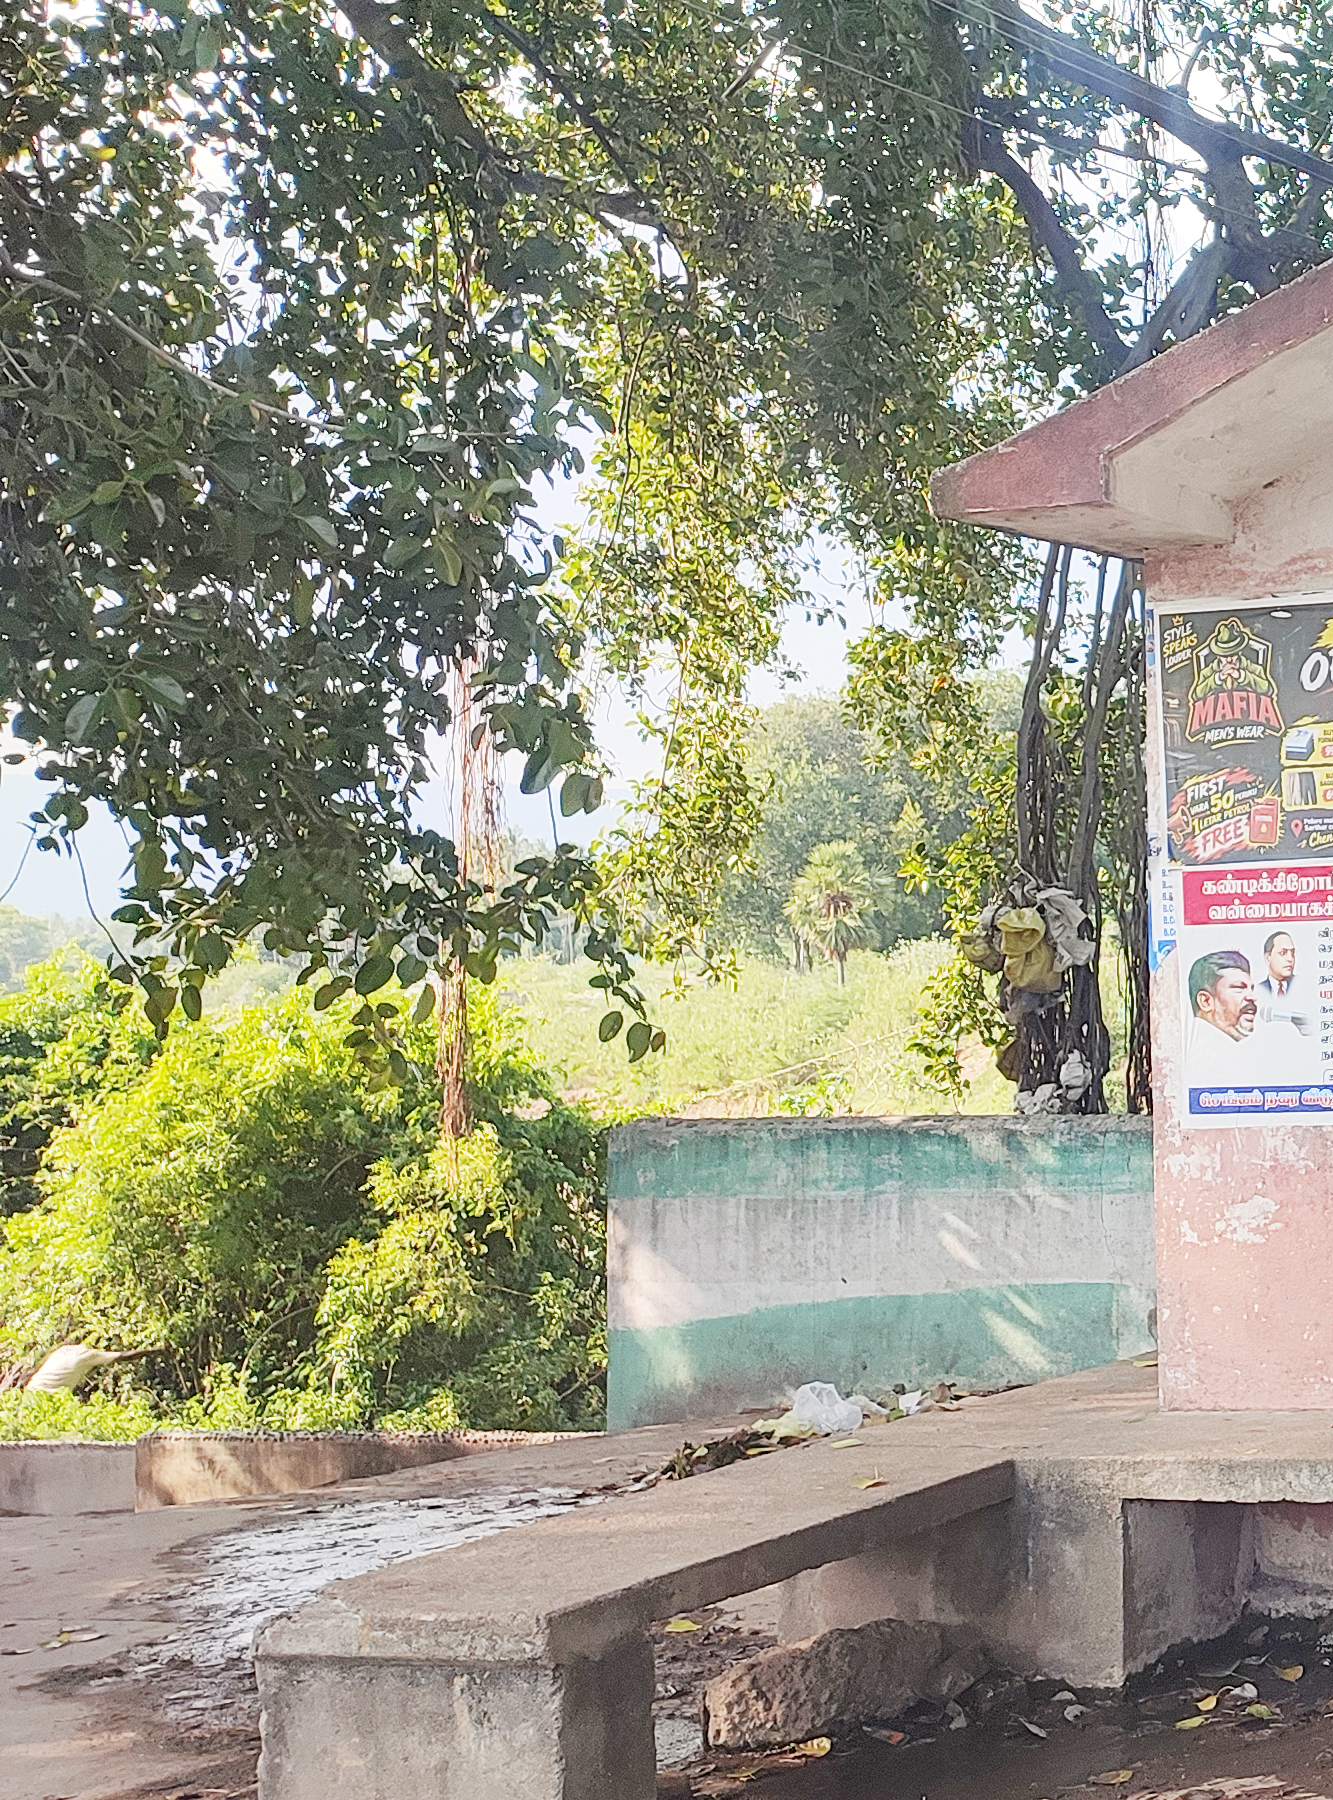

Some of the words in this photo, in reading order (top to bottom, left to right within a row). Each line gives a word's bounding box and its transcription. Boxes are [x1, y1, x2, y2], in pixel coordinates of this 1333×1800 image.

[1163, 621, 1193, 644] STYLE
[1162, 633, 1198, 657] SPEAKS
[1164, 648, 1192, 669] LOUDER
[1191, 691, 1281, 733] MAFIA
[1204, 726, 1235, 744] MEN'S
[1235, 725, 1265, 739] WEAR
[1186, 775, 1227, 803] FIRST
[1189, 802, 1210, 816] VARA
[1210, 789, 1235, 813] 50
[1192, 817, 1200, 836] 1
[1200, 813, 1222, 830] LETAR
[1201, 820, 1246, 853] FREE
